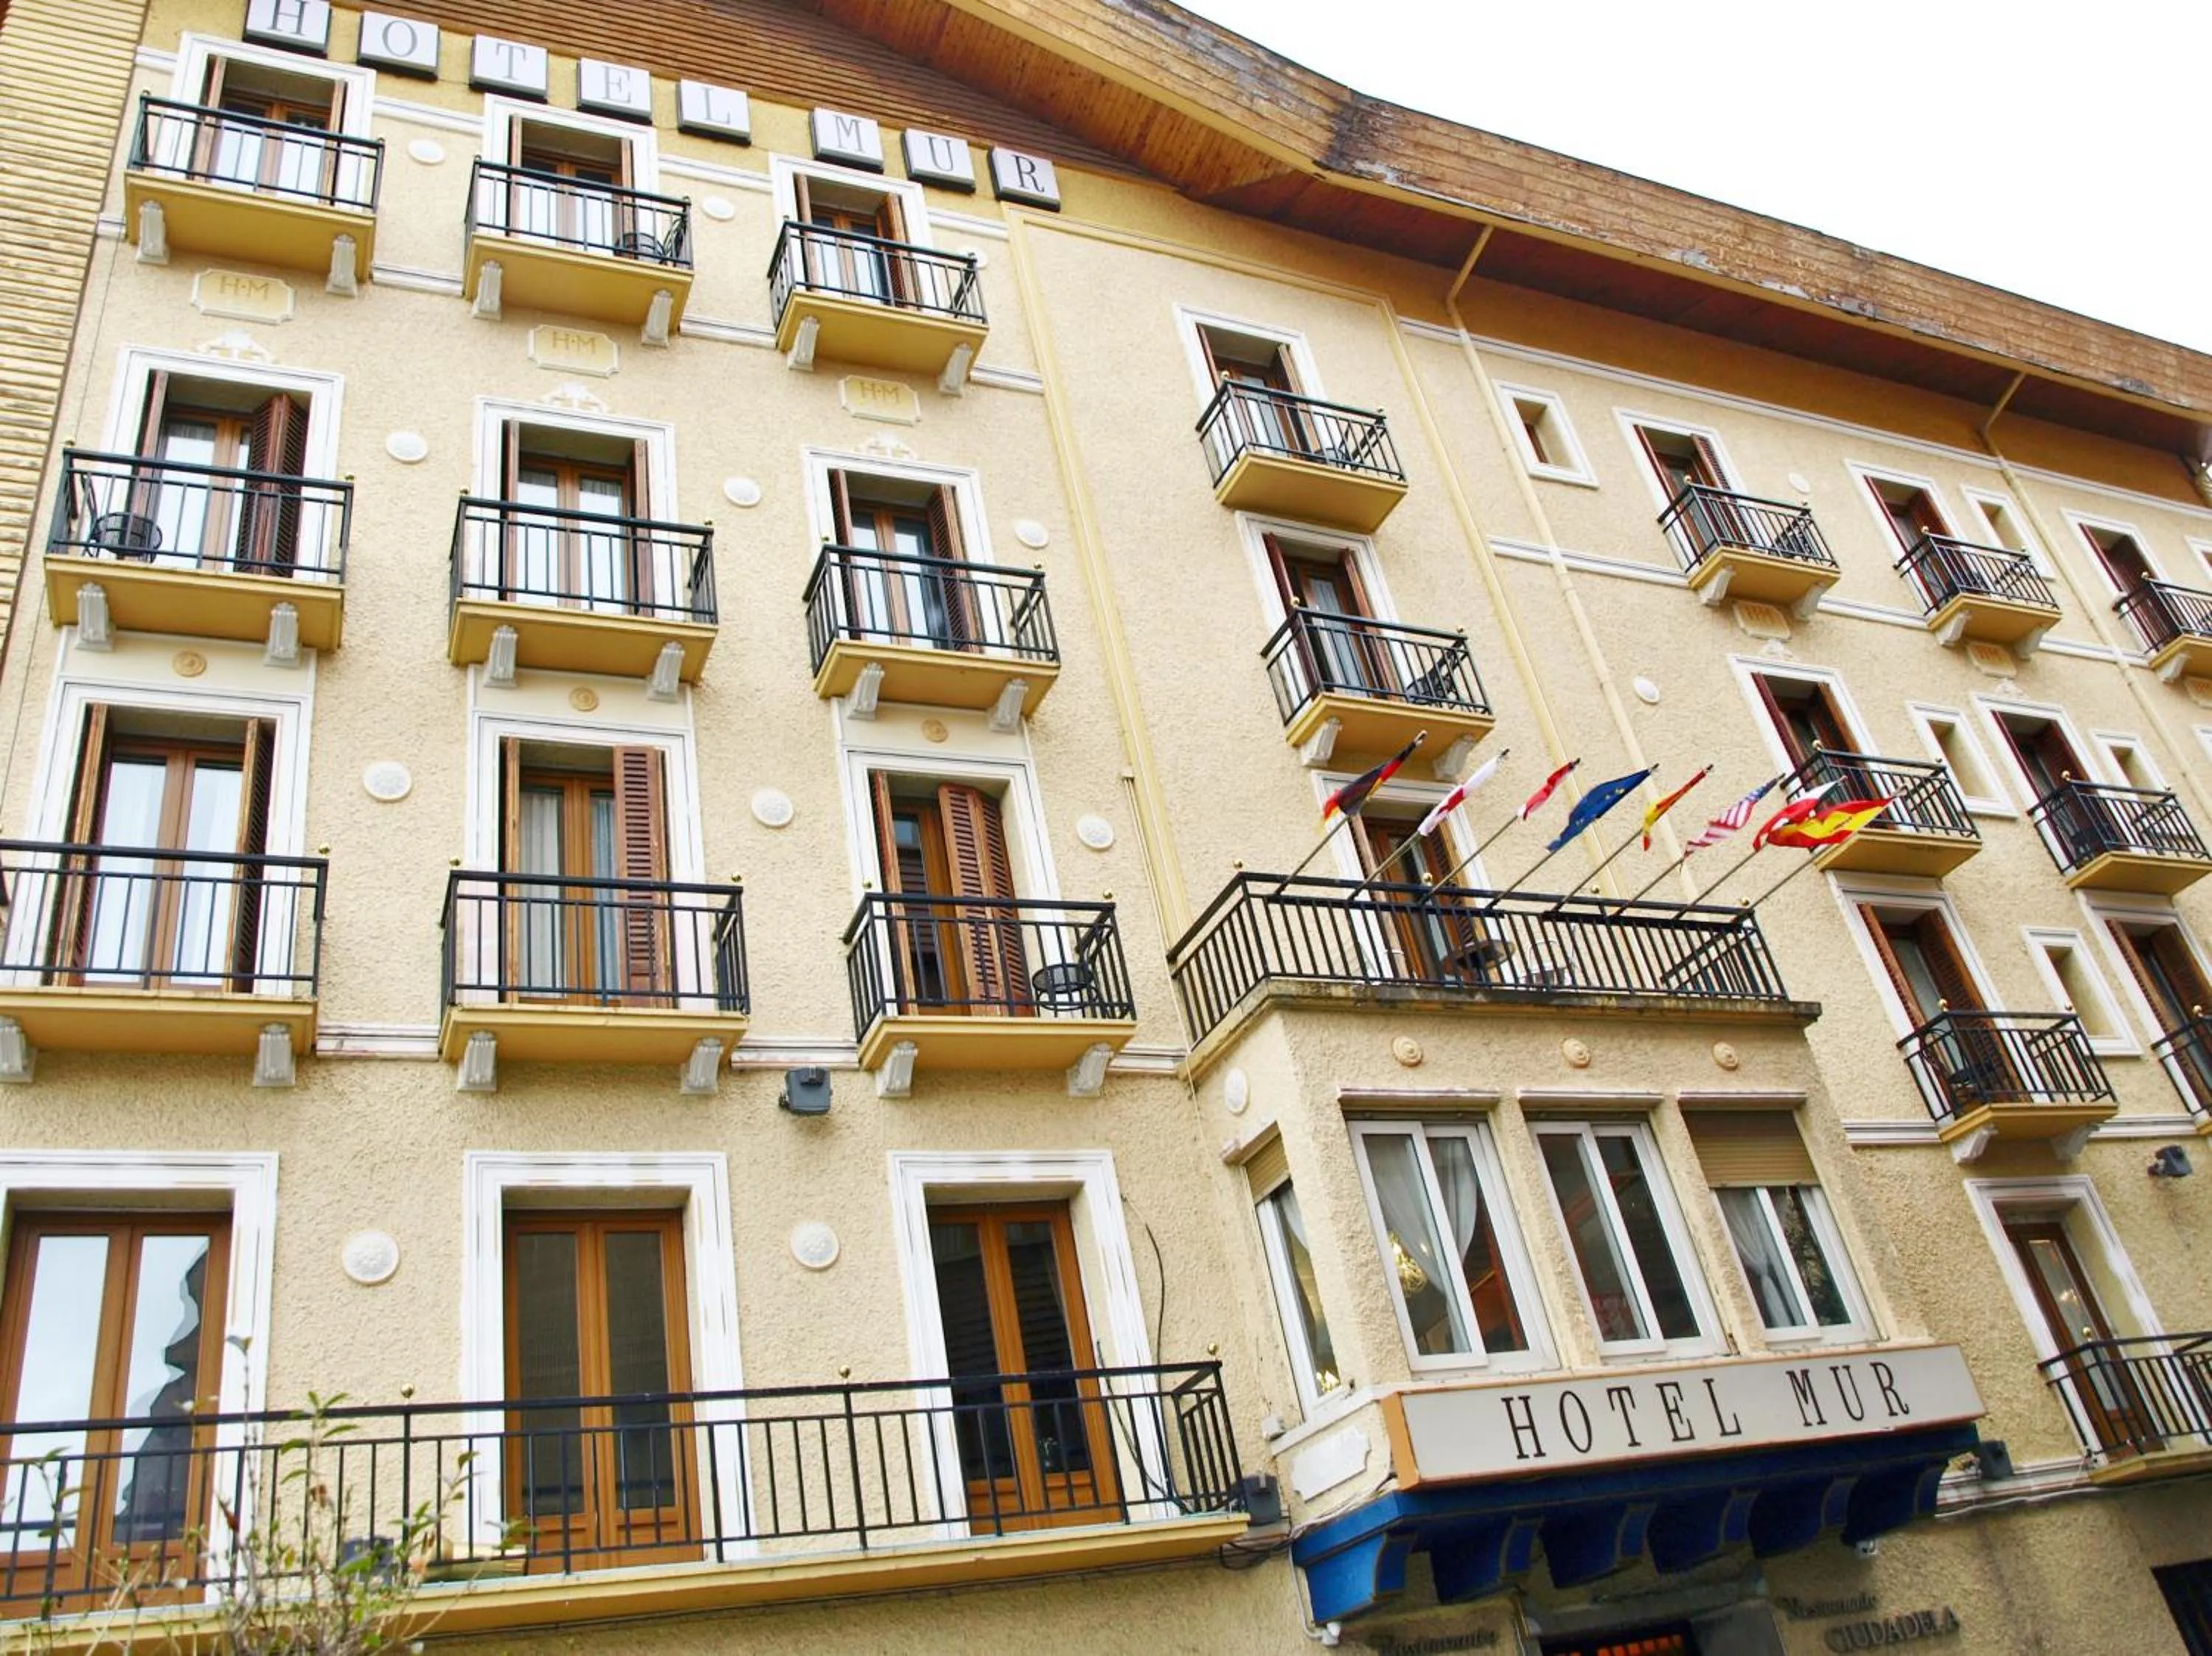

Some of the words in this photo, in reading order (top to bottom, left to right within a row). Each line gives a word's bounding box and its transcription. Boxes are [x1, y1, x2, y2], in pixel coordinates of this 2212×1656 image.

[266, 0, 731, 125] HOTEL
[832, 114, 1046, 194] MUR
[1500, 1378, 1742, 1460] HOTEL
[1785, 1361, 1910, 1427] MUR
